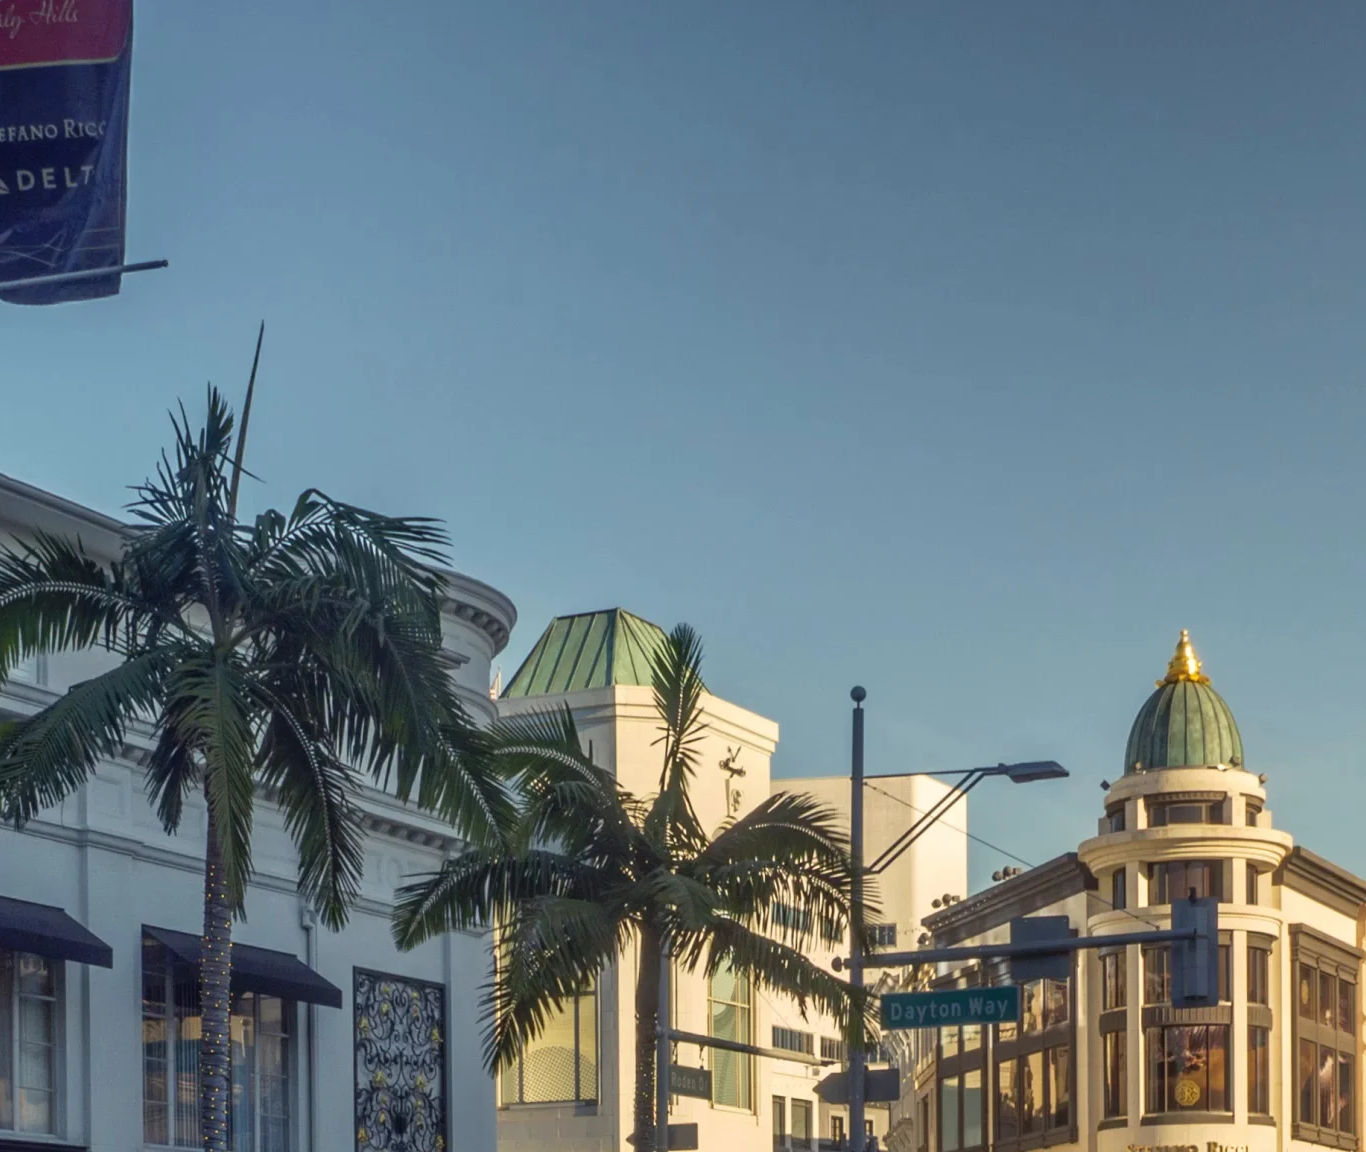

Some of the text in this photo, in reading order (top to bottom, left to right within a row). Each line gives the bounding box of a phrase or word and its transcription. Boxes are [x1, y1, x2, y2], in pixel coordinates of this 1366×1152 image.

[63, 118, 107, 141] RICC
[16, 164, 97, 192] DELT
[890, 996, 1008, 1024] Dayton Way
[671, 1071, 696, 1090] Rodeo
